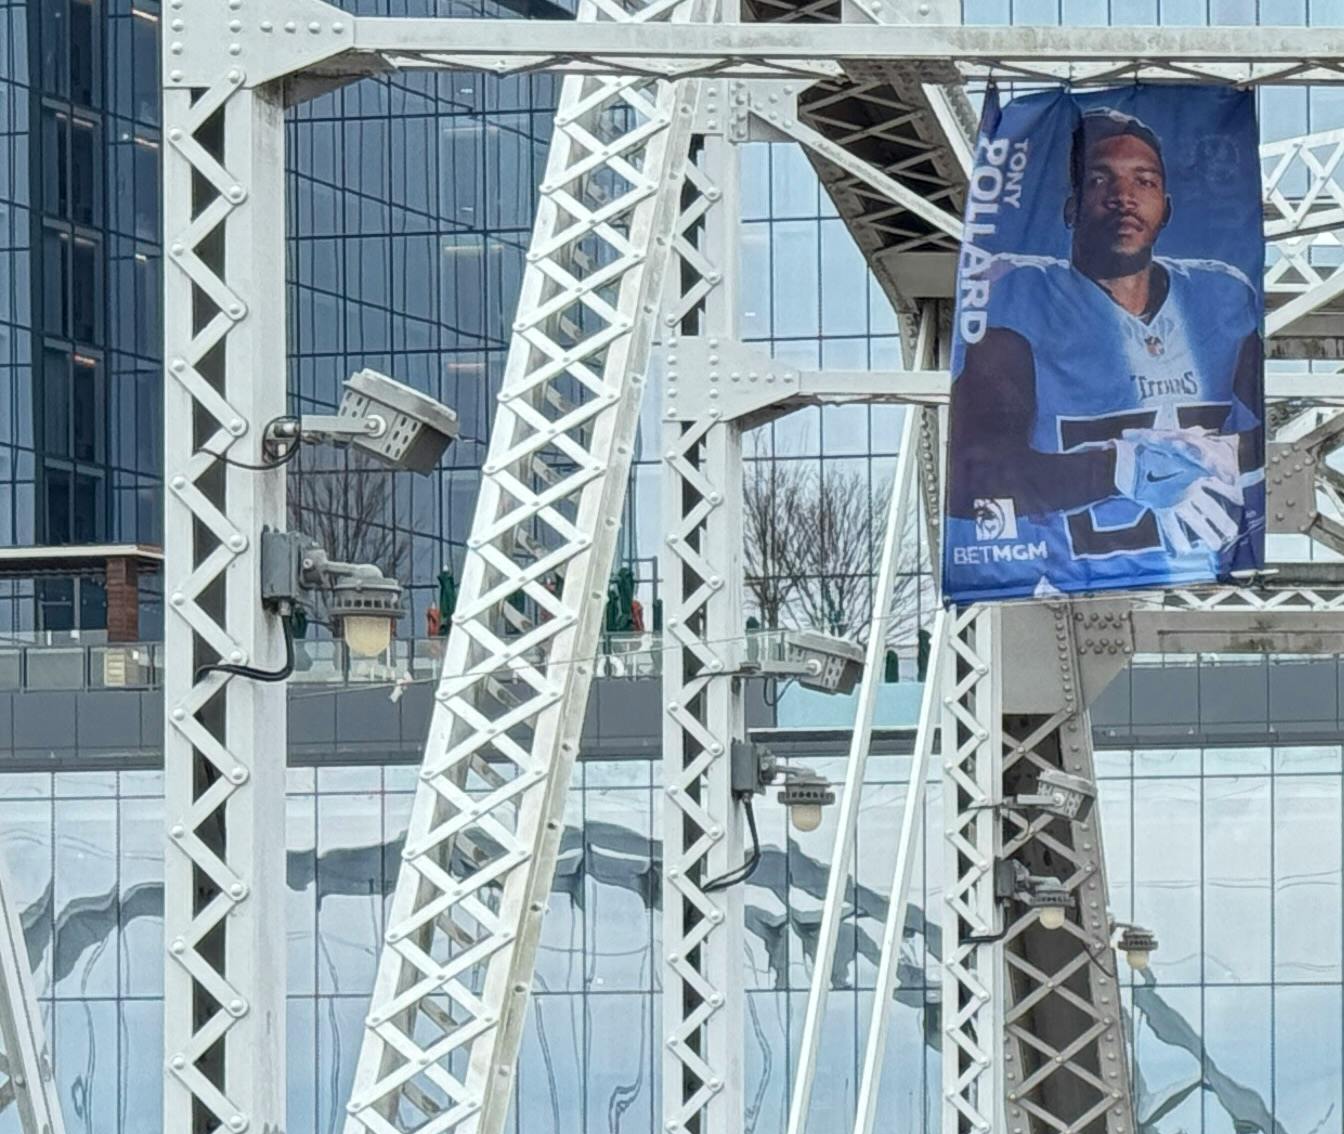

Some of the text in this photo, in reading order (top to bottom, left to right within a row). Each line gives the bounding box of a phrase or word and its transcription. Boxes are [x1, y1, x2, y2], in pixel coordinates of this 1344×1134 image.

[1003, 138, 1028, 208] TONY
[960, 136, 1009, 344] POLLARD
[953, 540, 1048, 565] BETMGM
